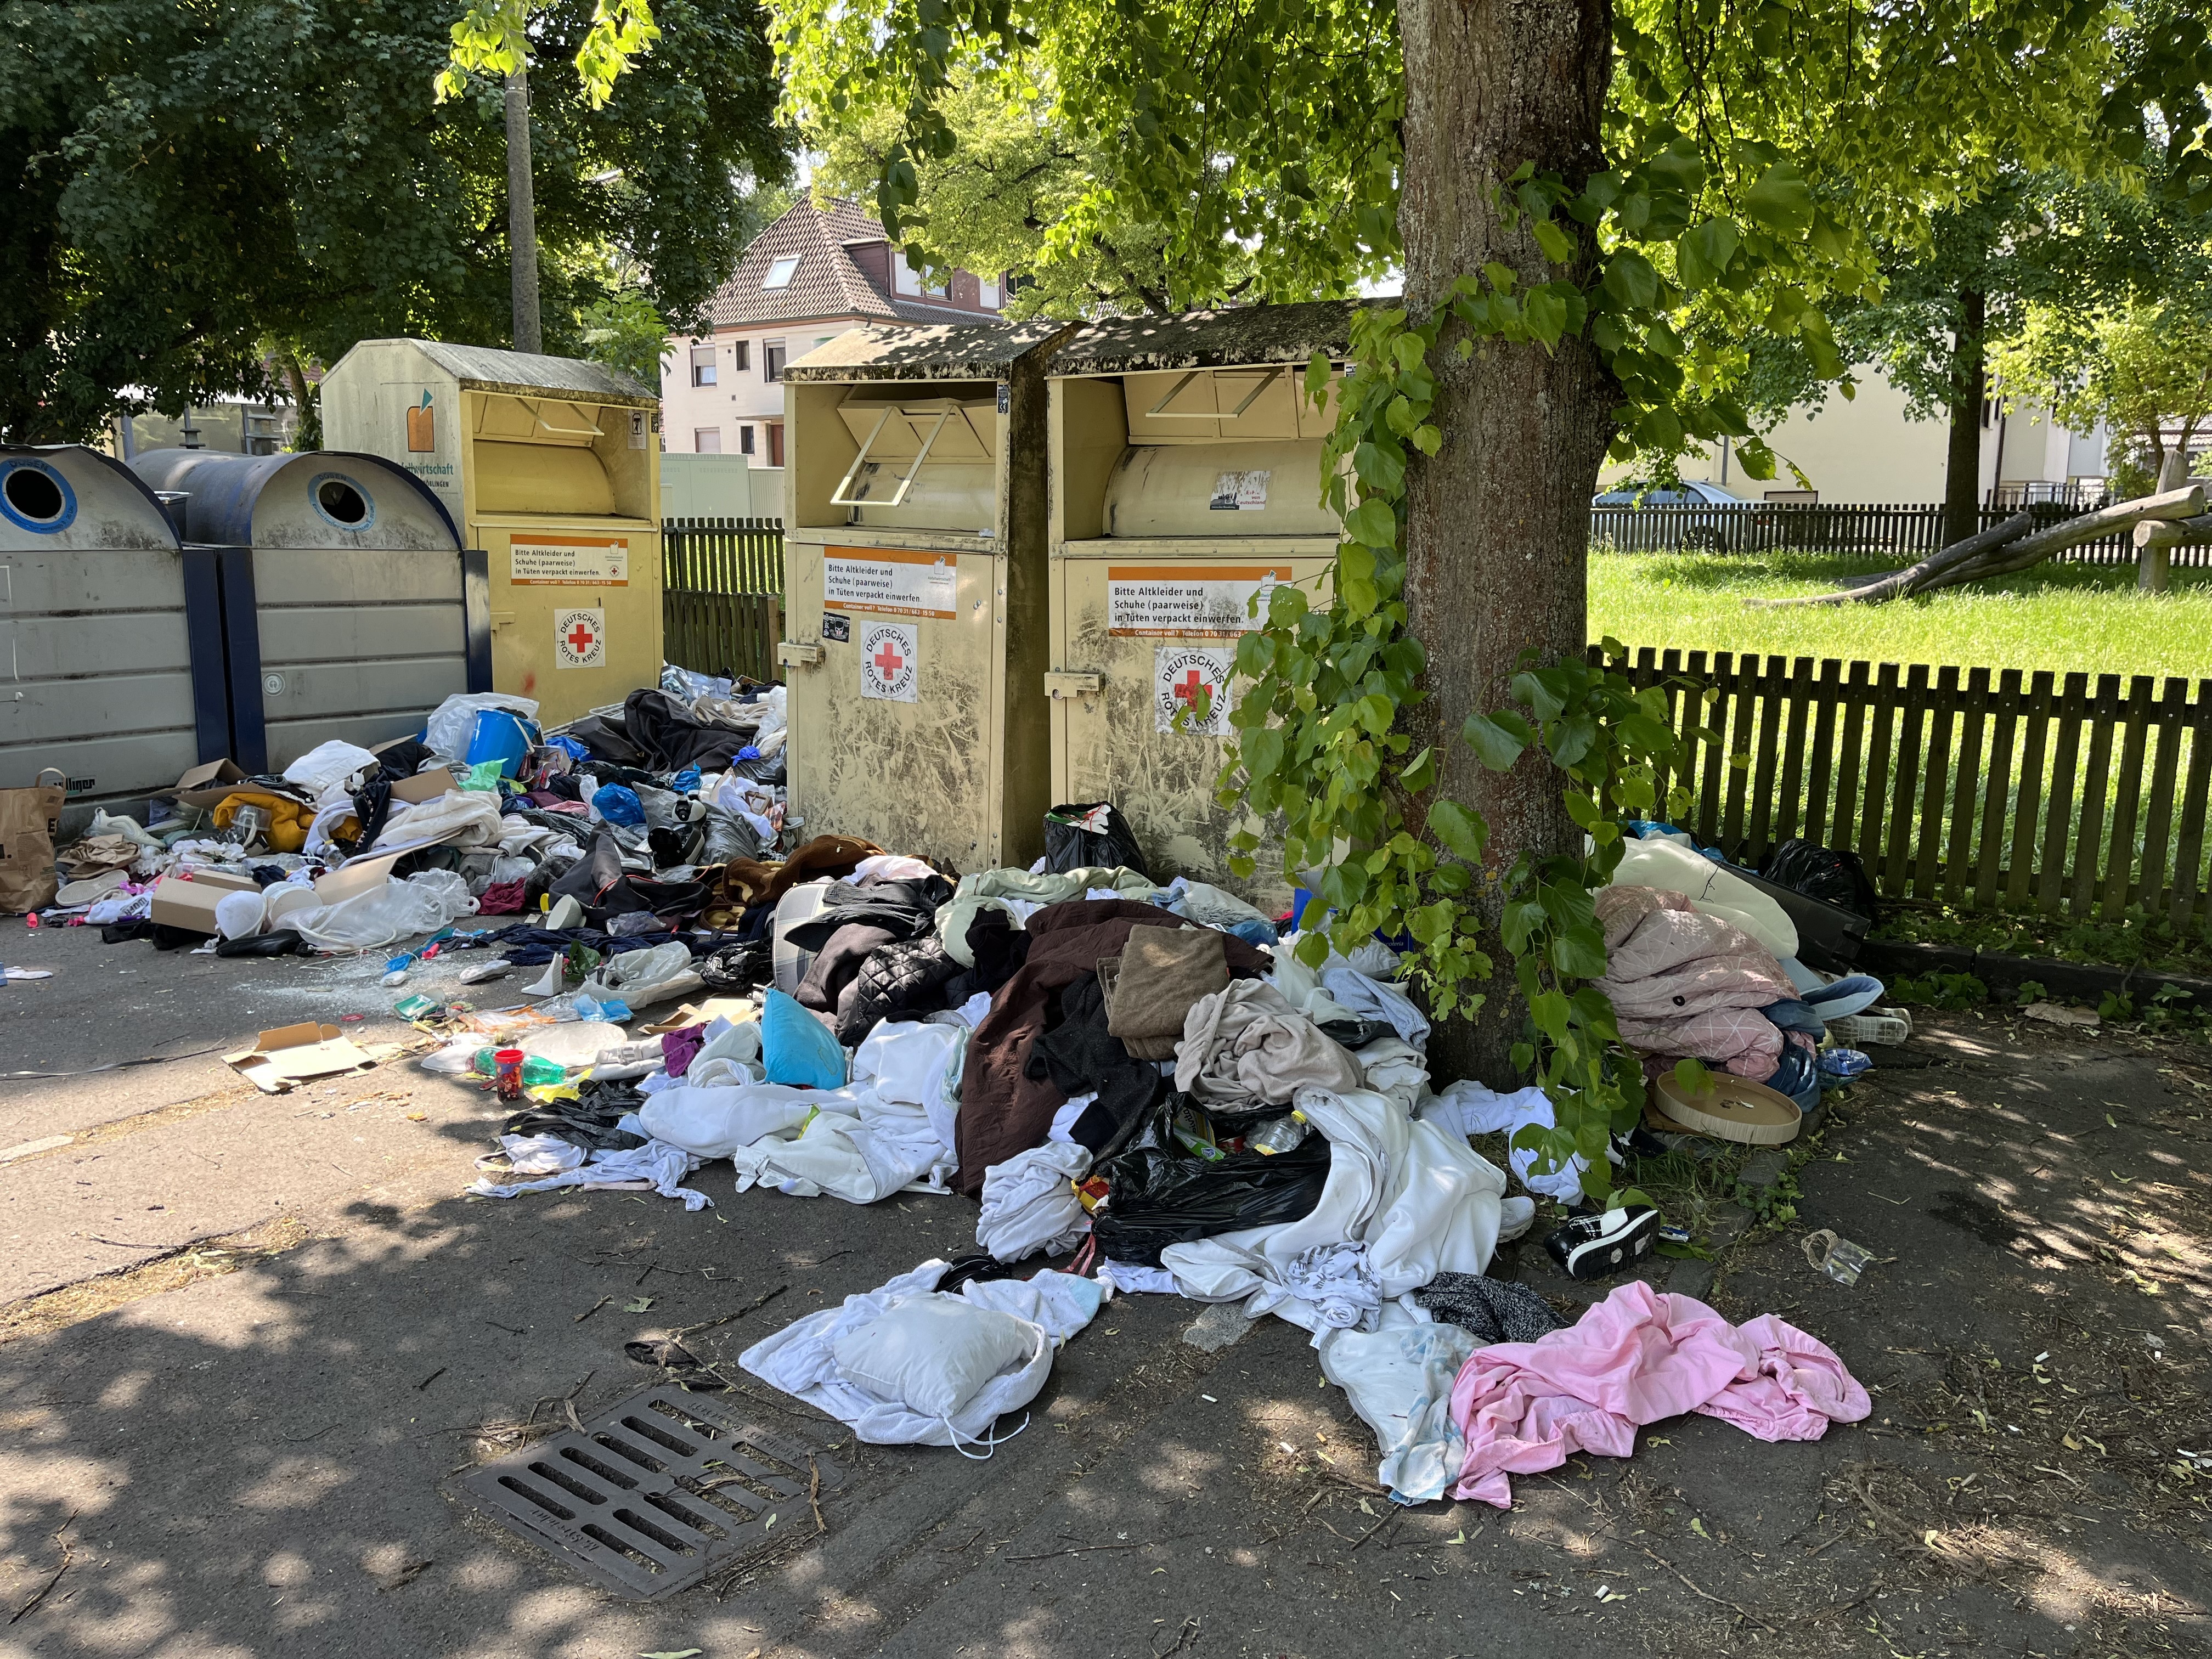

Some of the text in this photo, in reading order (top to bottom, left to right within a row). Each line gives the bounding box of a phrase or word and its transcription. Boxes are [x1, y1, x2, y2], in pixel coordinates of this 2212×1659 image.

[396, 462, 453, 475] llwirtschaft
[828, 564, 843, 572] Bitte
[846, 565, 878, 575] Altkleider
[828, 575, 892, 589] Schuhe (paarweise)
[836, 588, 854, 596] Tüten
[856, 591, 884, 600] verpackt
[885, 592, 922, 602] einwerfen.
[1115, 587, 1203, 596] Bitte Altkleider und
[1115, 600, 1203, 611] Schuhe (paarweise)
[560, 613, 600, 633] DEUTSCHES
[1115, 612, 1244, 624] in Tüten verpackt einwerfen.
[866, 629, 911, 656] DEUTSCHES
[560, 639, 601, 663] ROTES KREUZ
[1163, 654, 1224, 684] DEUTSCHES
[865, 661, 912, 693] ROTES KREUZ
[1161, 692, 1226, 726] ROTS KREUZ
